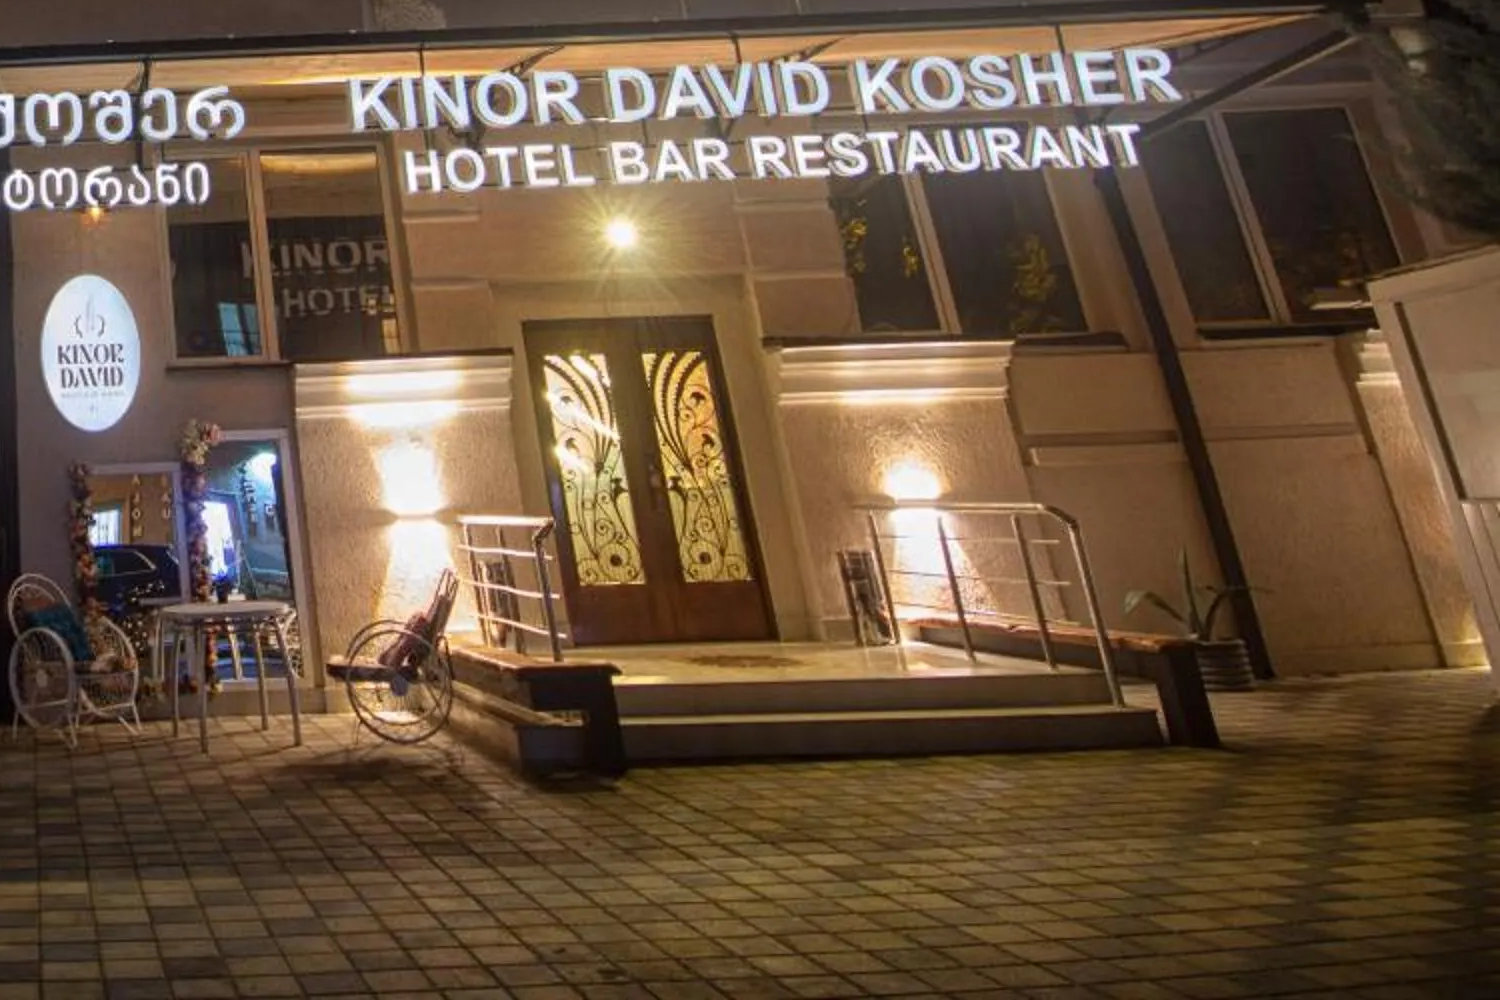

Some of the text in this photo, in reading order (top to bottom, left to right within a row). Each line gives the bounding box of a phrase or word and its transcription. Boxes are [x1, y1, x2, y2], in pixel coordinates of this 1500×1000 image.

[347, 47, 1182, 131] KINOR DAVID KOSHER
[404, 123, 1142, 194] HOTEL BAR RESTAURANT
[57, 343, 125, 365] KINOR
[60, 366, 125, 389] DAVID
